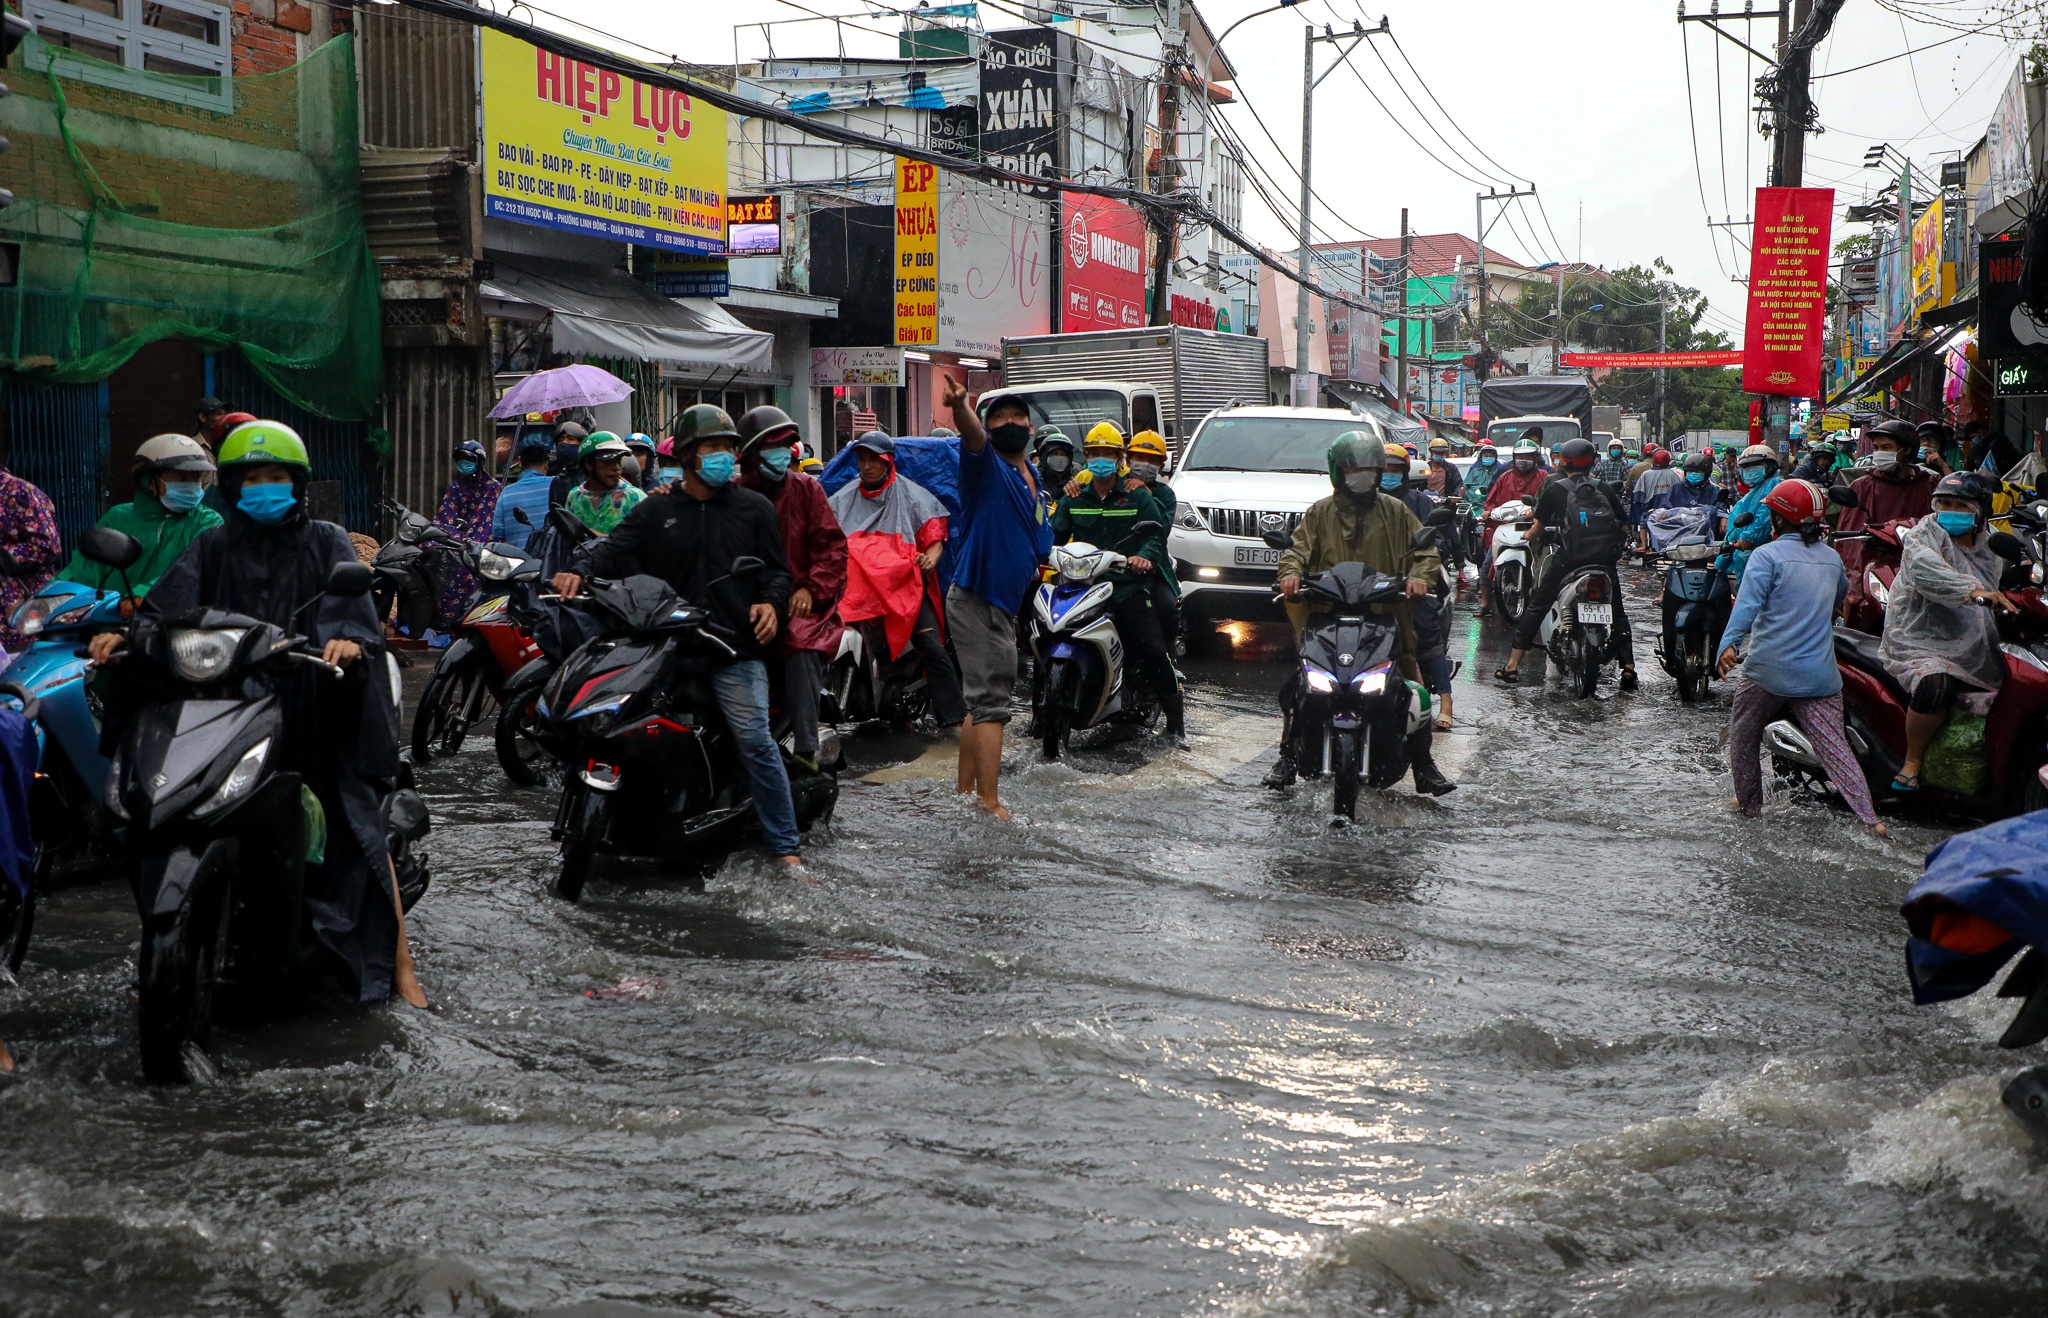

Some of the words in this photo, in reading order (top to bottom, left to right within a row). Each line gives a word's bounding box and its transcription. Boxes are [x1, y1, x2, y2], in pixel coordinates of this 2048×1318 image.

[986, 47, 1006, 69] ÁO
[1015, 42, 1051, 68] CƯỚI
[986, 79, 1052, 131] XUÂN
[595, 136, 614, 155] Mua
[618, 143, 634, 160] Bán
[637, 148, 651, 165] Các
[499, 142, 516, 162] BAO
[519, 144, 534, 166] VẢI
[542, 153, 559, 172] BAO
[562, 158, 573, 174] PP
[581, 163, 591, 180] PE
[599, 166, 614, 185] DÂY
[617, 172, 631, 191] NẸP
[639, 177, 652, 196] BẠT
[655, 177, 668, 196] XẾP
[675, 185, 688, 203] BẠT
[690, 187, 702, 204] MÁI
[704, 190, 719, 208] HIÊN
[903, 159, 933, 193] ÉP
[498, 170, 515, 191] BẠT
[518, 174, 535, 195] SỌC
[538, 179, 554, 197] CHE
[558, 183, 576, 202] MƯA
[584, 186, 600, 207] BẢO
[602, 192, 612, 213] HỘ
[615, 197, 628, 213] LAO
[631, 198, 651, 219] ĐỘNG
[658, 206, 672, 225] PHỤ
[674, 207, 690, 228] KIỆN
[692, 211, 705, 228] CÁC
[707, 215, 721, 234] LOẠI
[728, 204, 754, 224] BẠT
[897, 202, 936, 241] NHỰA
[1782, 214, 1794, 222] BẦU
[1796, 214, 1804, 222] CỬ
[506, 203, 516, 213] 212
[526, 207, 541, 219] NGỌC
[542, 210, 553, 221] VÂN
[558, 213, 579, 226] PHƯỜNG
[580, 218, 591, 228] LINH
[593, 220, 606, 231] ĐÔNG
[611, 224, 624, 236] QUẬN
[625, 226, 634, 238] THỦ
[635, 228, 645, 239] ĐỨC
[664, 234, 672, 243] 028
[686, 238, 694, 248] 510
[1777, 225, 1790, 233] BIỂU
[1792, 225, 1807, 233] QUỐC
[1809, 226, 1818, 235] HỘI
[1774, 236, 1782, 244] VÀ
[1784, 237, 1793, 245] ĐẠI
[1795, 236, 1808, 244] BIỂU
[902, 250, 912, 267] ÉP
[916, 249, 934, 267] DẺO
[1091, 231, 1138, 273] HOMEFARM
[1761, 247, 1770, 255] HỘI
[1225, 257, 1242, 266] THIẾT
[1790, 257, 1802, 265] CẤP
[1770, 268, 1778, 276] LÀ
[1779, 269, 1793, 277] TRỰC
[1795, 268, 1808, 276] TIẾP
[896, 278, 906, 292] ÉP
[909, 277, 935, 292] CỨNG
[1802, 280, 1818, 288] DỰNG
[1802, 290, 1821, 298] QUYỀN
[897, 303, 914, 317] Các
[917, 303, 936, 318] Loại
[1770, 301, 1780, 309] HỘI
[1781, 300, 1793, 308] CHỦ
[1772, 312, 1784, 320] VIỆT
[898, 325, 918, 342] Giấy
[921, 327, 932, 341] Tờ
[2001, 365, 2028, 384] GIẤY
[1582, 614, 1610, 622] 171.60
